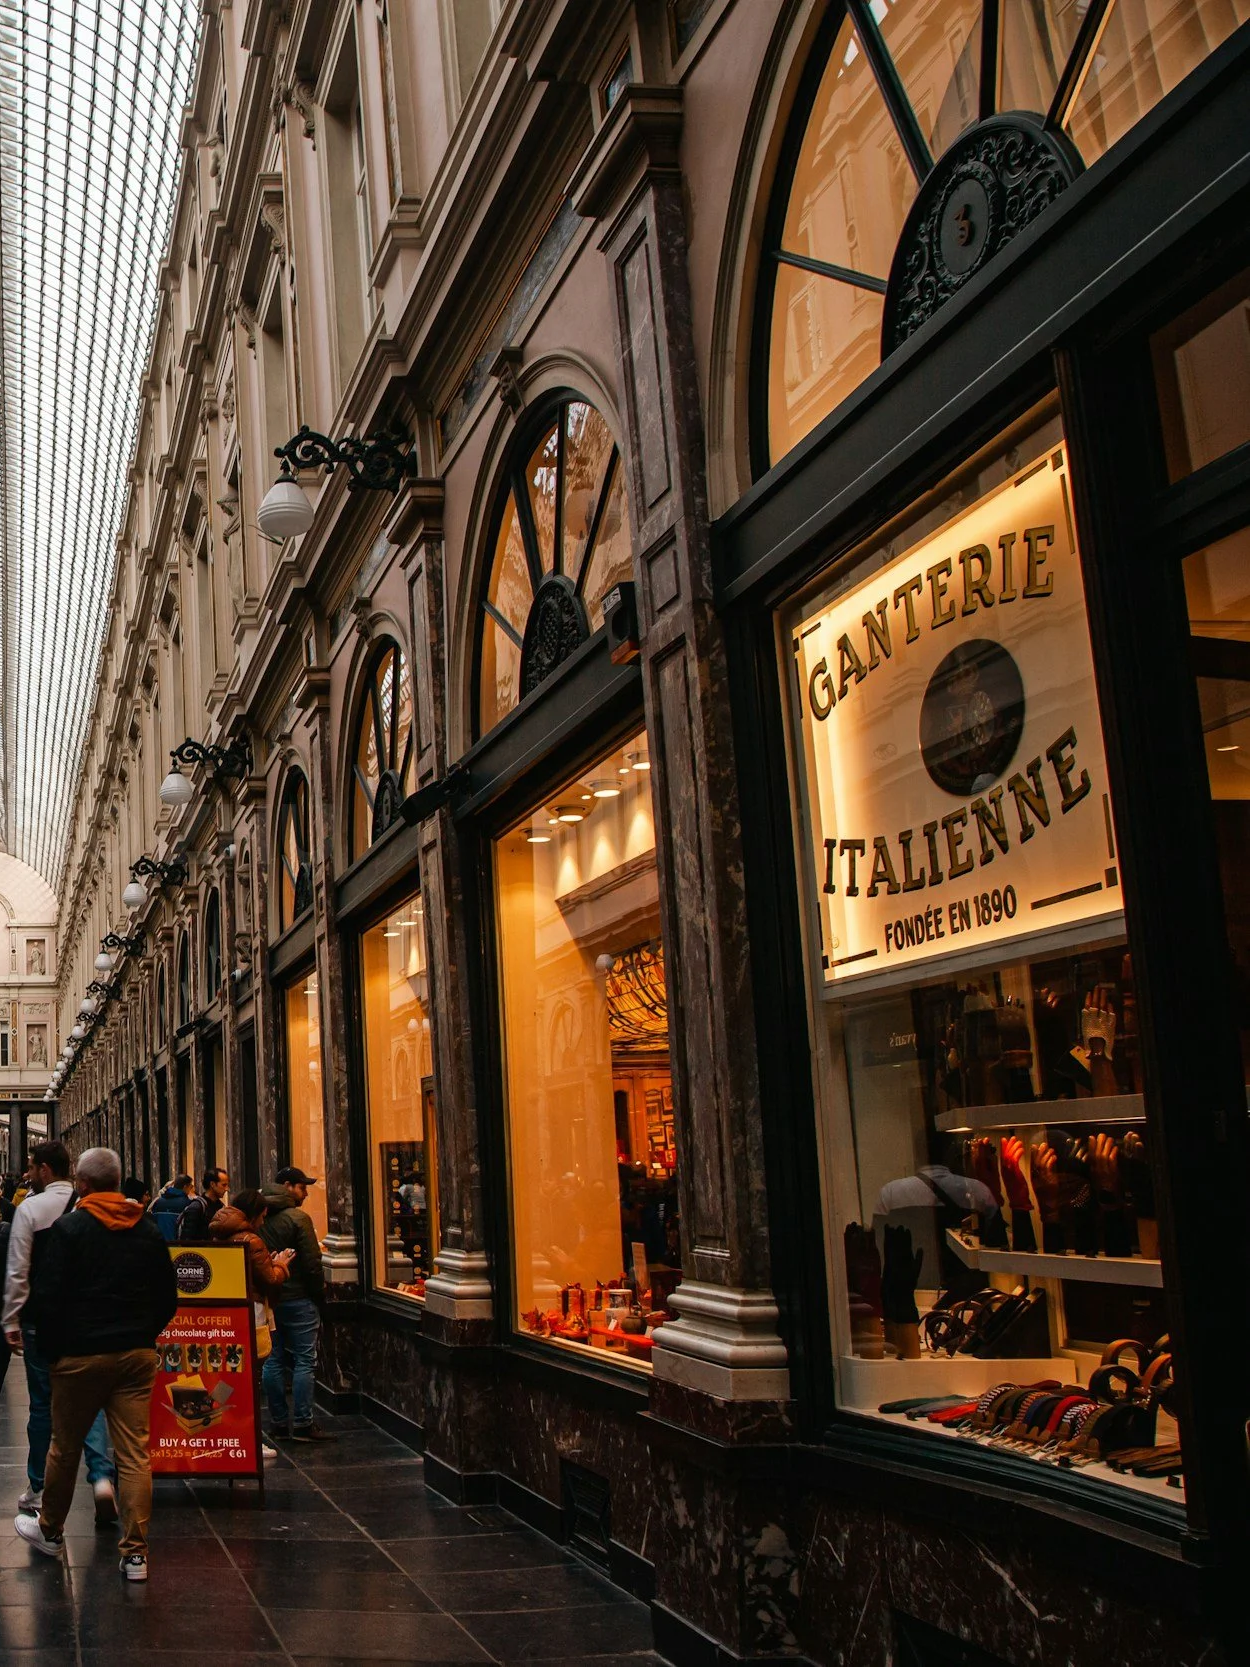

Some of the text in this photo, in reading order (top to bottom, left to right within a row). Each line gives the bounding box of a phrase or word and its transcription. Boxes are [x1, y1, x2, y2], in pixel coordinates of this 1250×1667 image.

[808, 525, 1055, 721] GANTERIE
[822, 725, 1092, 898] ITALIENNE
[884, 884, 1018, 953] FONDÉE EN 1890
[176, 1266, 205, 1275] CORNÉ
[197, 1316, 232, 1326] OFFER!
[171, 1328, 206, 1338] chocolate
[207, 1328, 221, 1339] gift
[220, 1328, 235, 1338] box
[159, 1438, 240, 1448] BUY 4 GET 1 FREE
